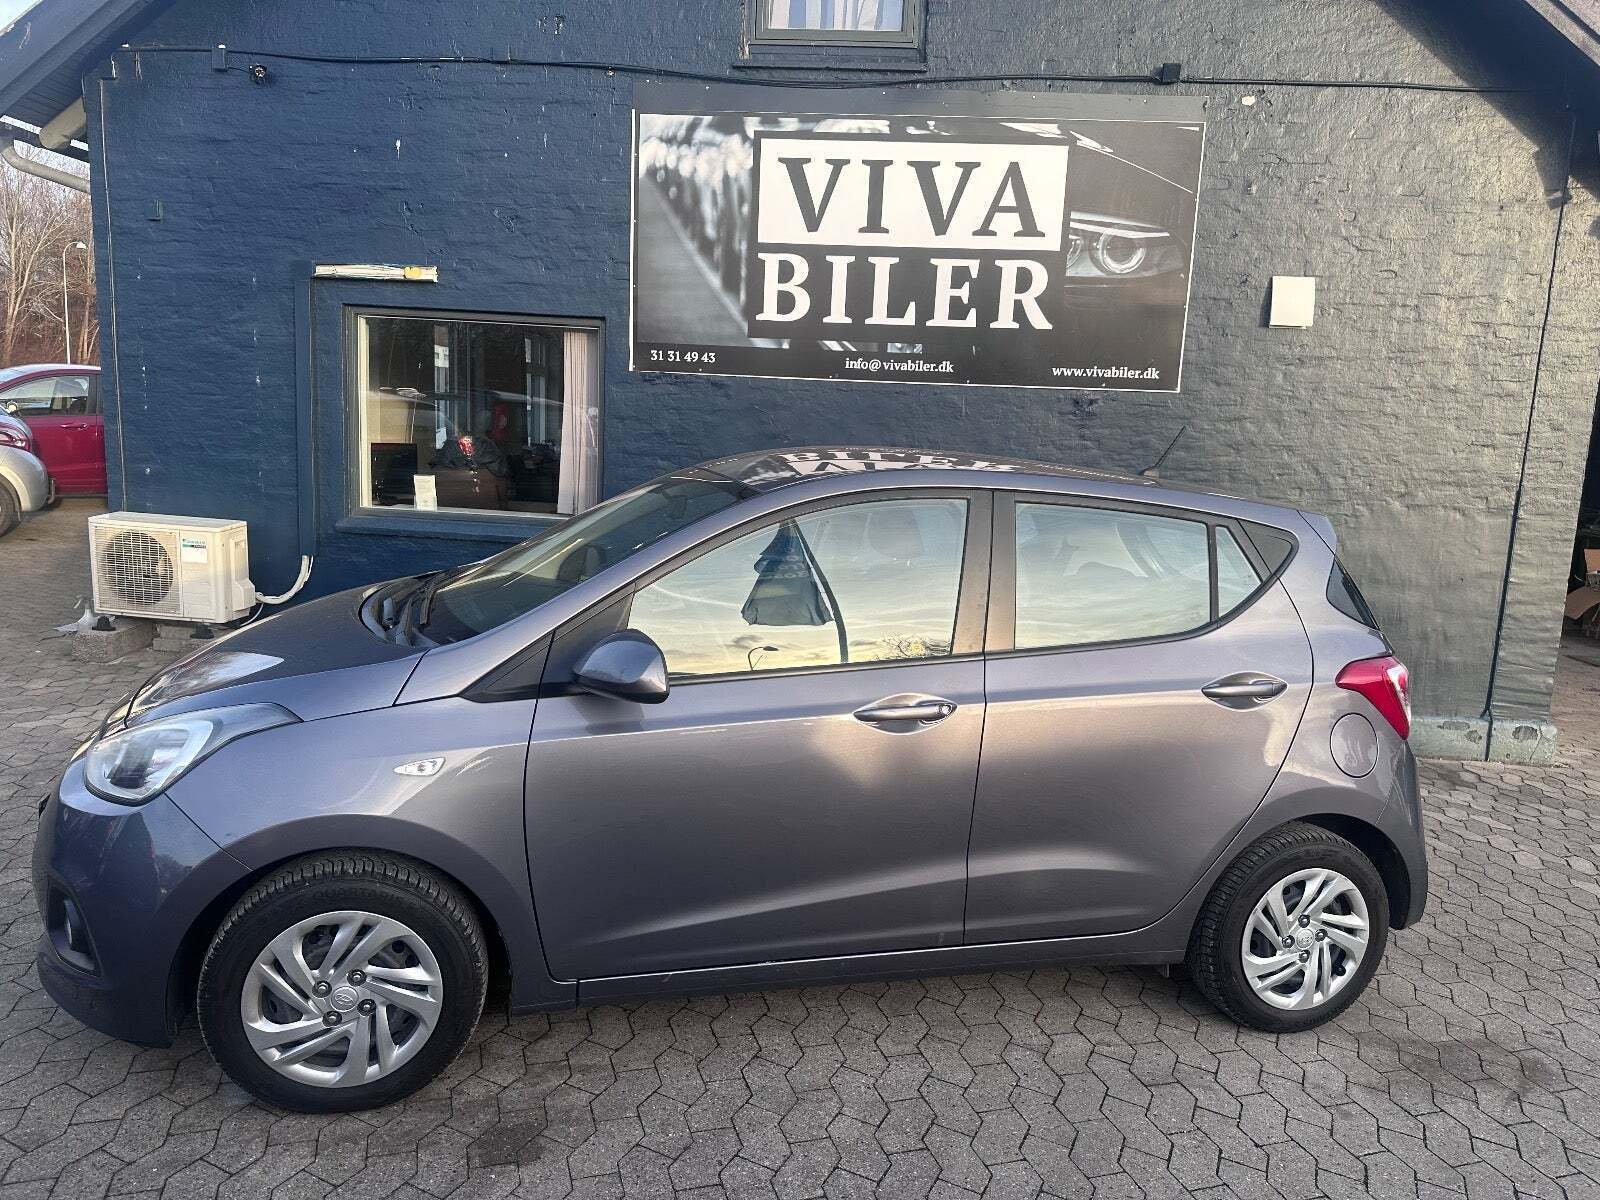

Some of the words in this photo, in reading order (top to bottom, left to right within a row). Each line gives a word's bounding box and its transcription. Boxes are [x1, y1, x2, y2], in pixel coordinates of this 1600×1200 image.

[777, 157, 1046, 236] VIVA
[755, 252, 1053, 330] BILER
[650, 350, 664, 361] 31
[667, 350, 681, 362] 31
[684, 351, 699, 363] 49
[700, 352, 716, 363] 43
[1052, 366, 1159, 379] www.vivabiler.dk
